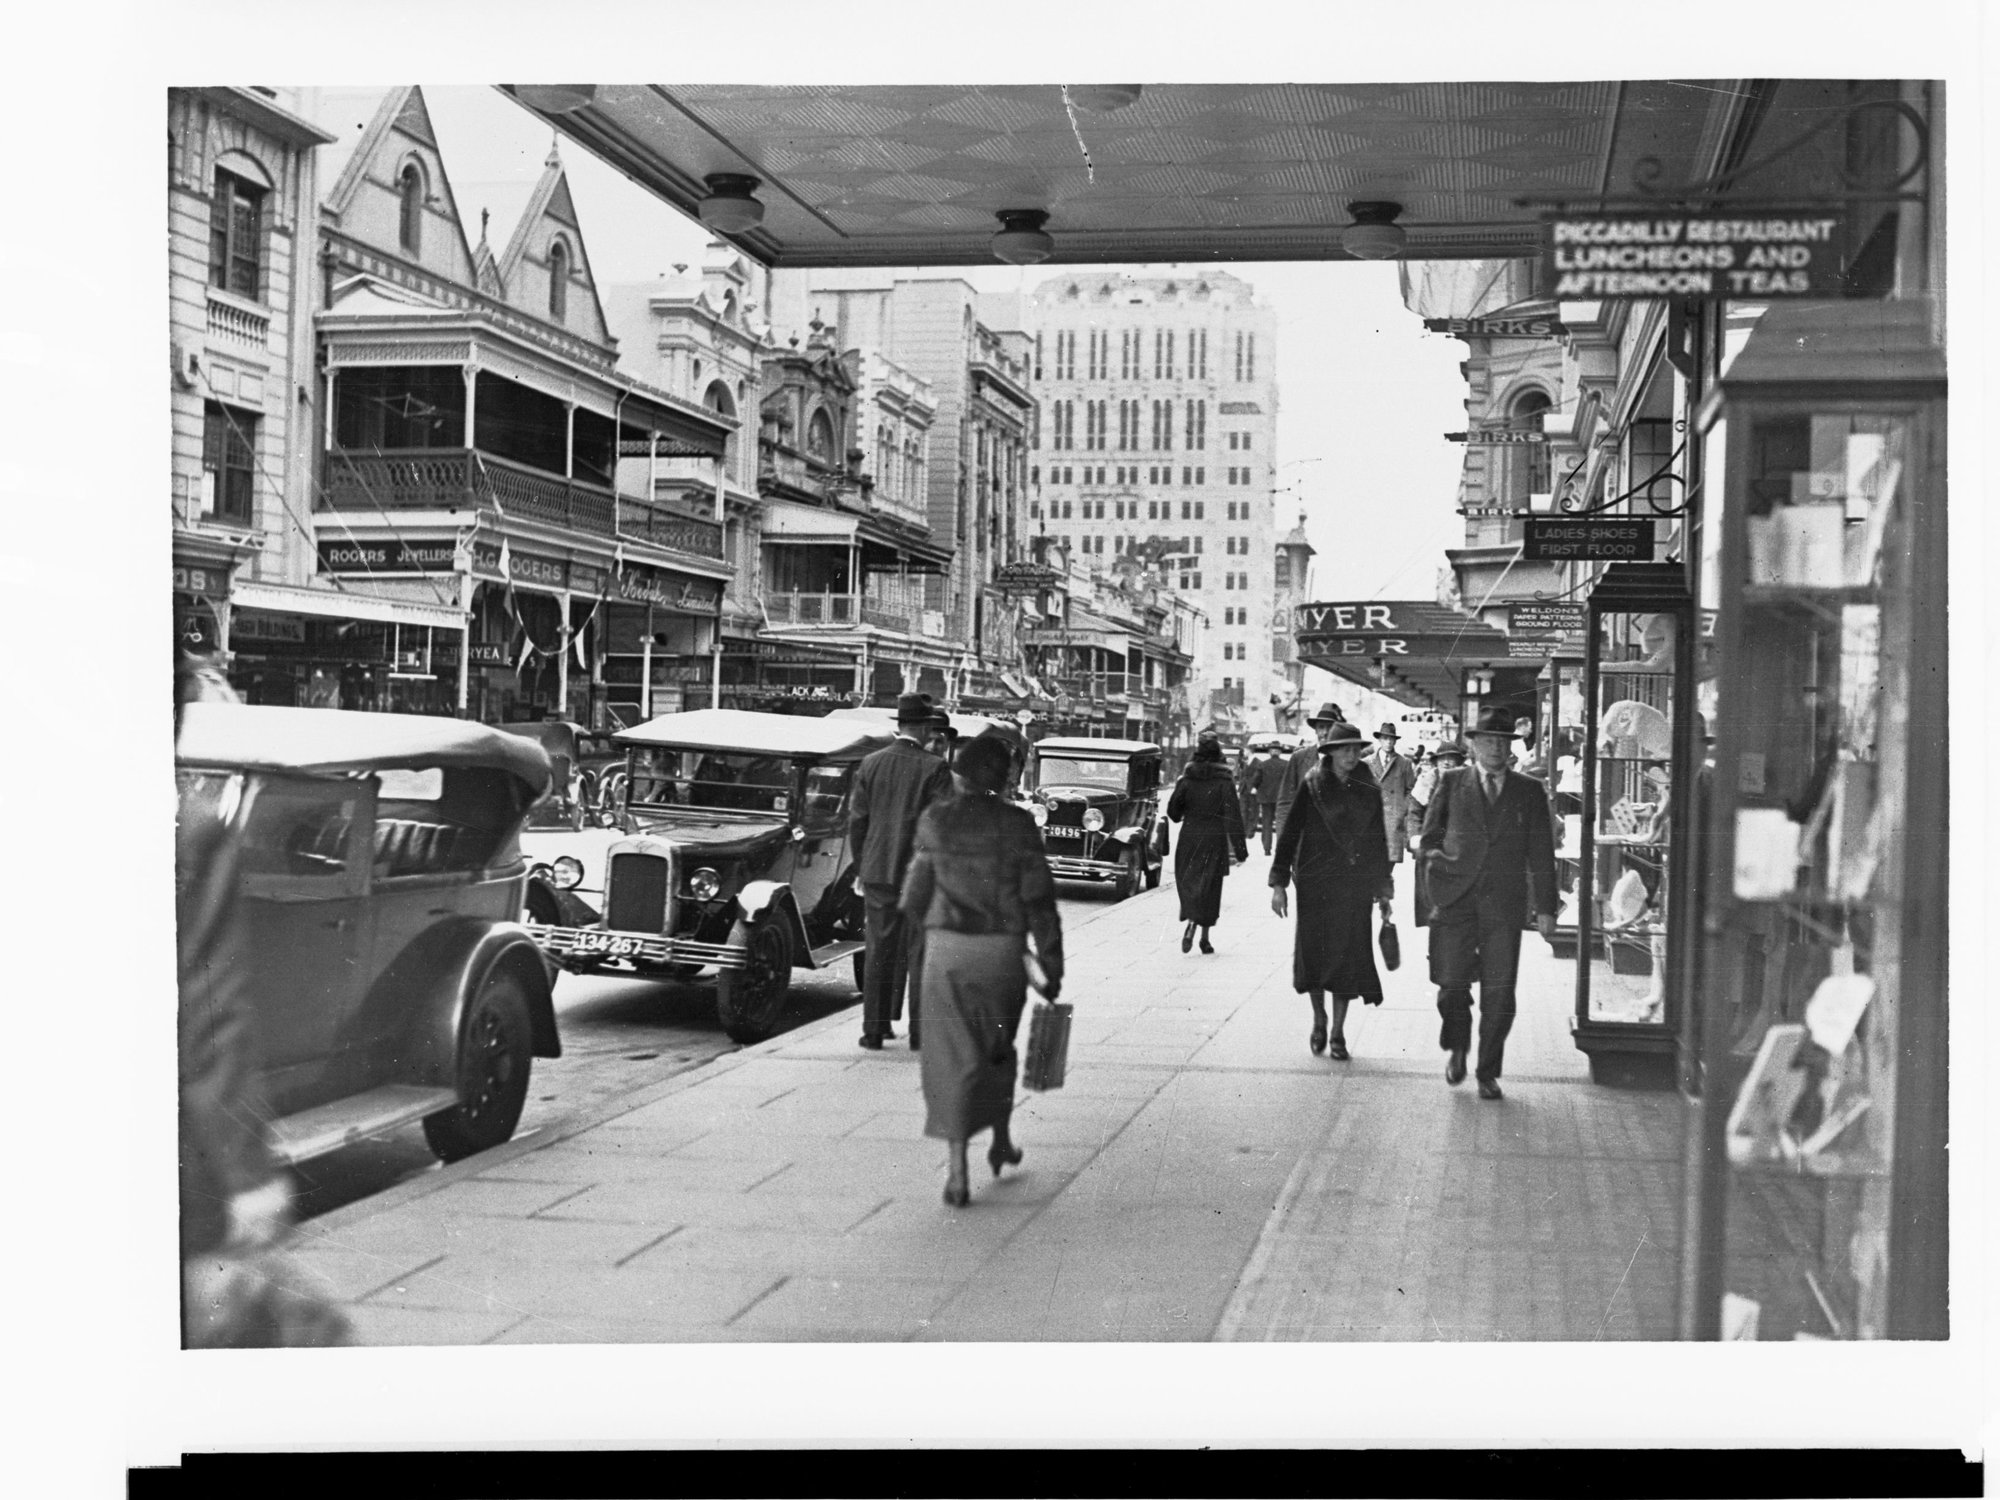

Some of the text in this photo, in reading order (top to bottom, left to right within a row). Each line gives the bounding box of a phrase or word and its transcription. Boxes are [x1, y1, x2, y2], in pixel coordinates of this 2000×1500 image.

[1553, 219, 1837, 243] PICCADILLY RESTAURANT
[1555, 245, 1812, 270] LUNCHEONS AND
[1555, 270, 1811, 294] AFTERNOON TEAS
[1448, 319, 1551, 334] BIRKS
[1534, 528, 1638, 539] LADIES SHOES
[1540, 544, 1636, 555] FIRST FLOOR
[510, 556, 562, 580] OGERS
[1300, 639, 1409, 655] MYER
